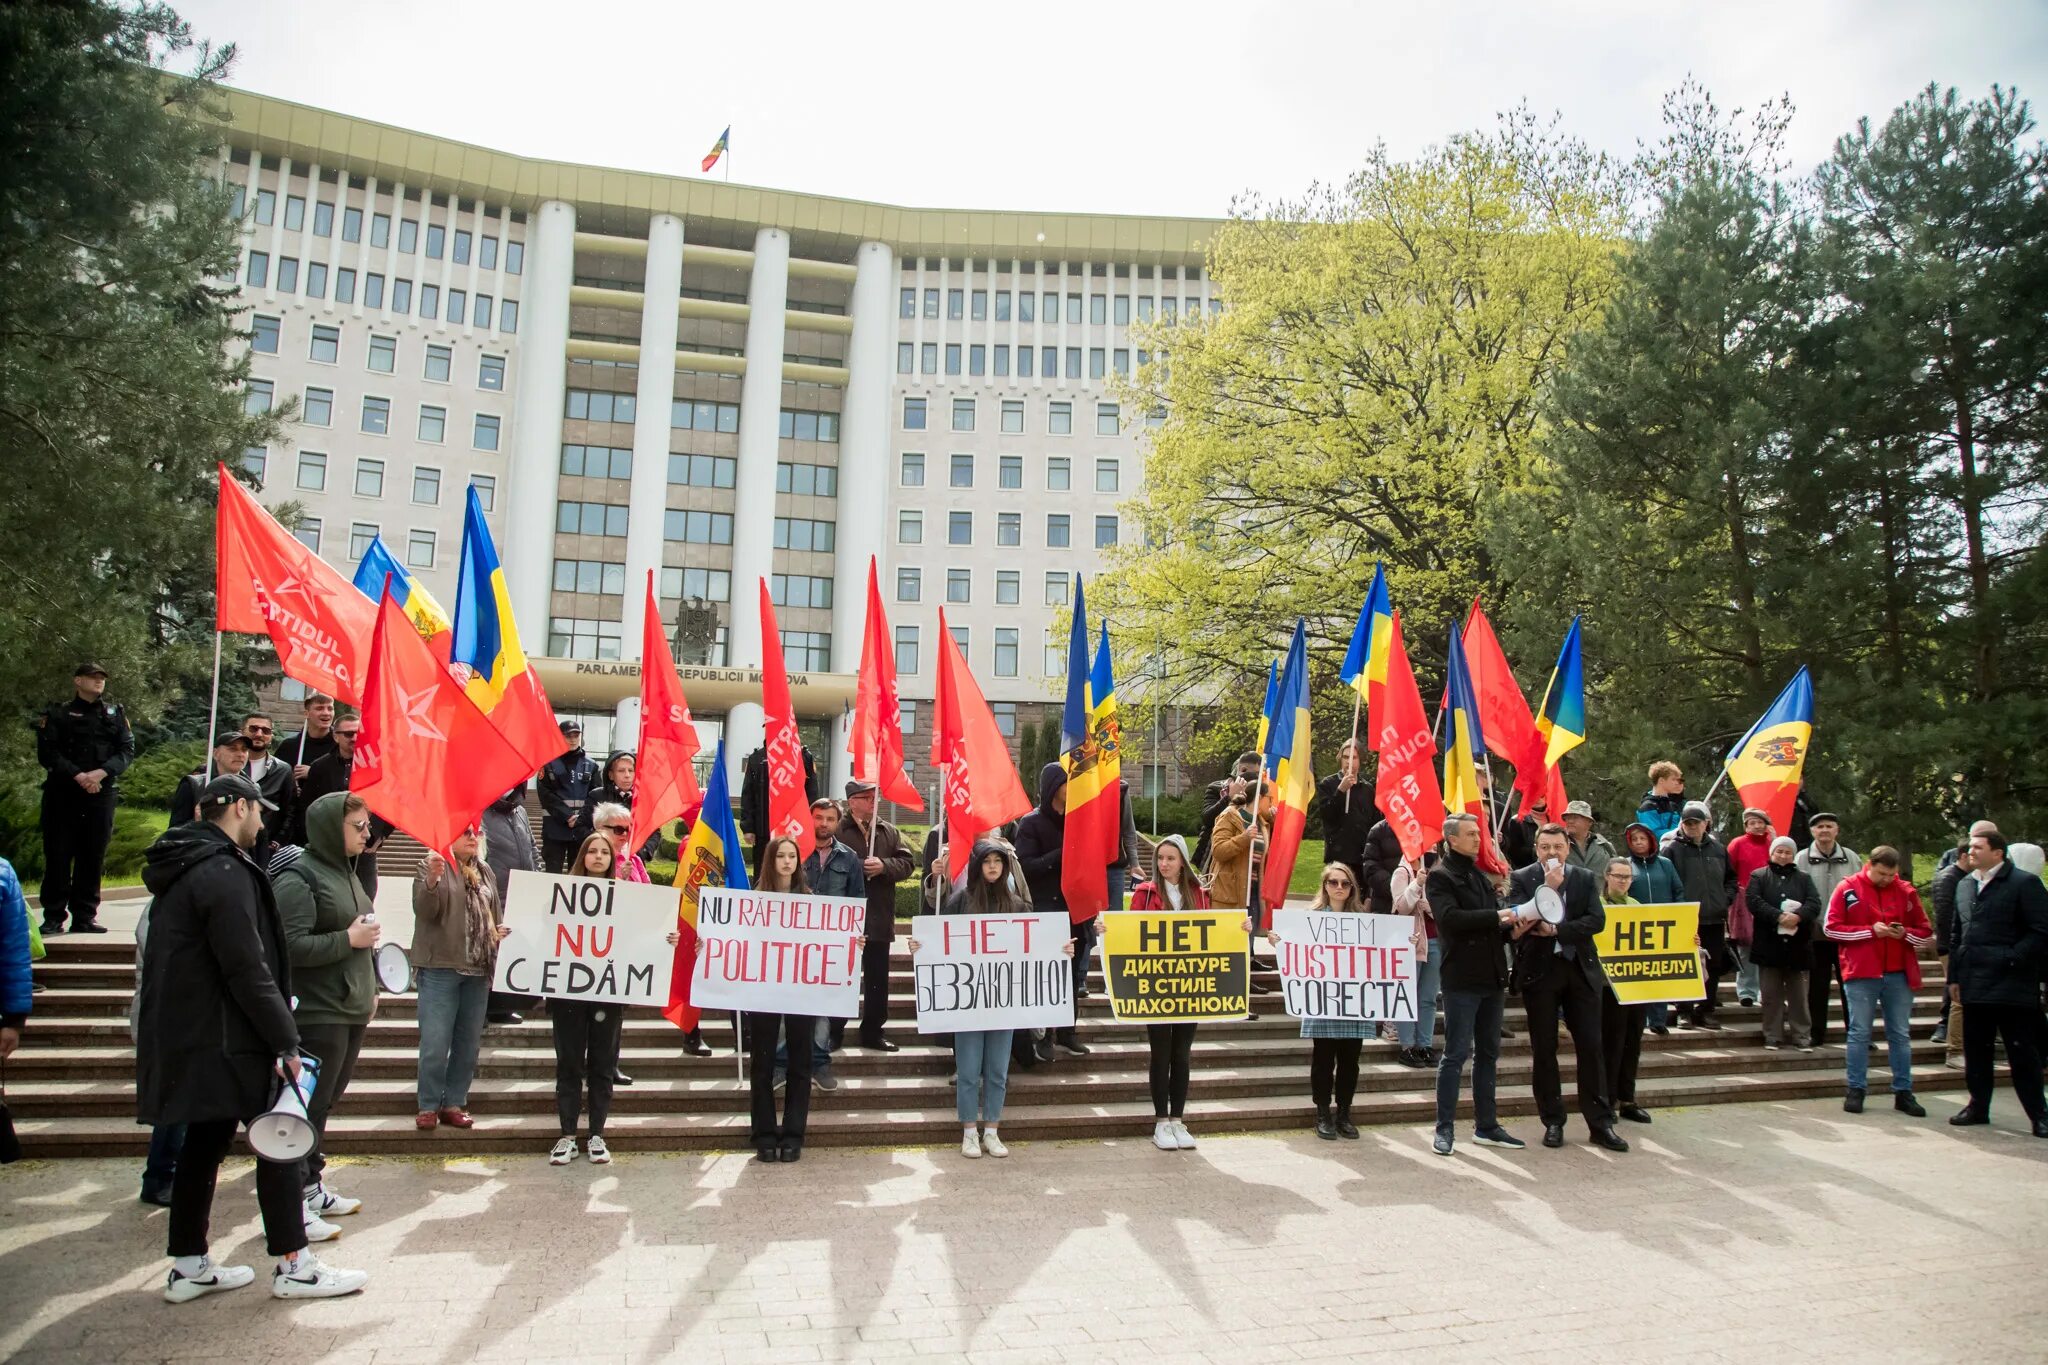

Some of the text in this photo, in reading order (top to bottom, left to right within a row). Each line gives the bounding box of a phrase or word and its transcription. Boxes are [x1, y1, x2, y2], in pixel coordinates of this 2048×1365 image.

[676, 668, 744, 682] REPUBLICII
[701, 896, 864, 933] NU RĂFUELILOR
[1307, 916, 1375, 945] VREM
[555, 923, 614, 958] NU
[943, 918, 1040, 956] НЕТ
[1140, 919, 1217, 952] НЕТ
[1614, 920, 1677, 951] НЕТ
[506, 957, 654, 996] CEDĂM
[704, 936, 857, 987] POLITICE!
[1122, 956, 1231, 977] ДИКТАТУРЕ
[915, 959, 1068, 1012] БЕЗЗАКОНИЮ!
[1138, 976, 1217, 994] В СТИЛЕ
[1287, 979, 1415, 1019] CORECTĂ
[1115, 995, 1246, 1015] ПЛАХОТНЮКА
